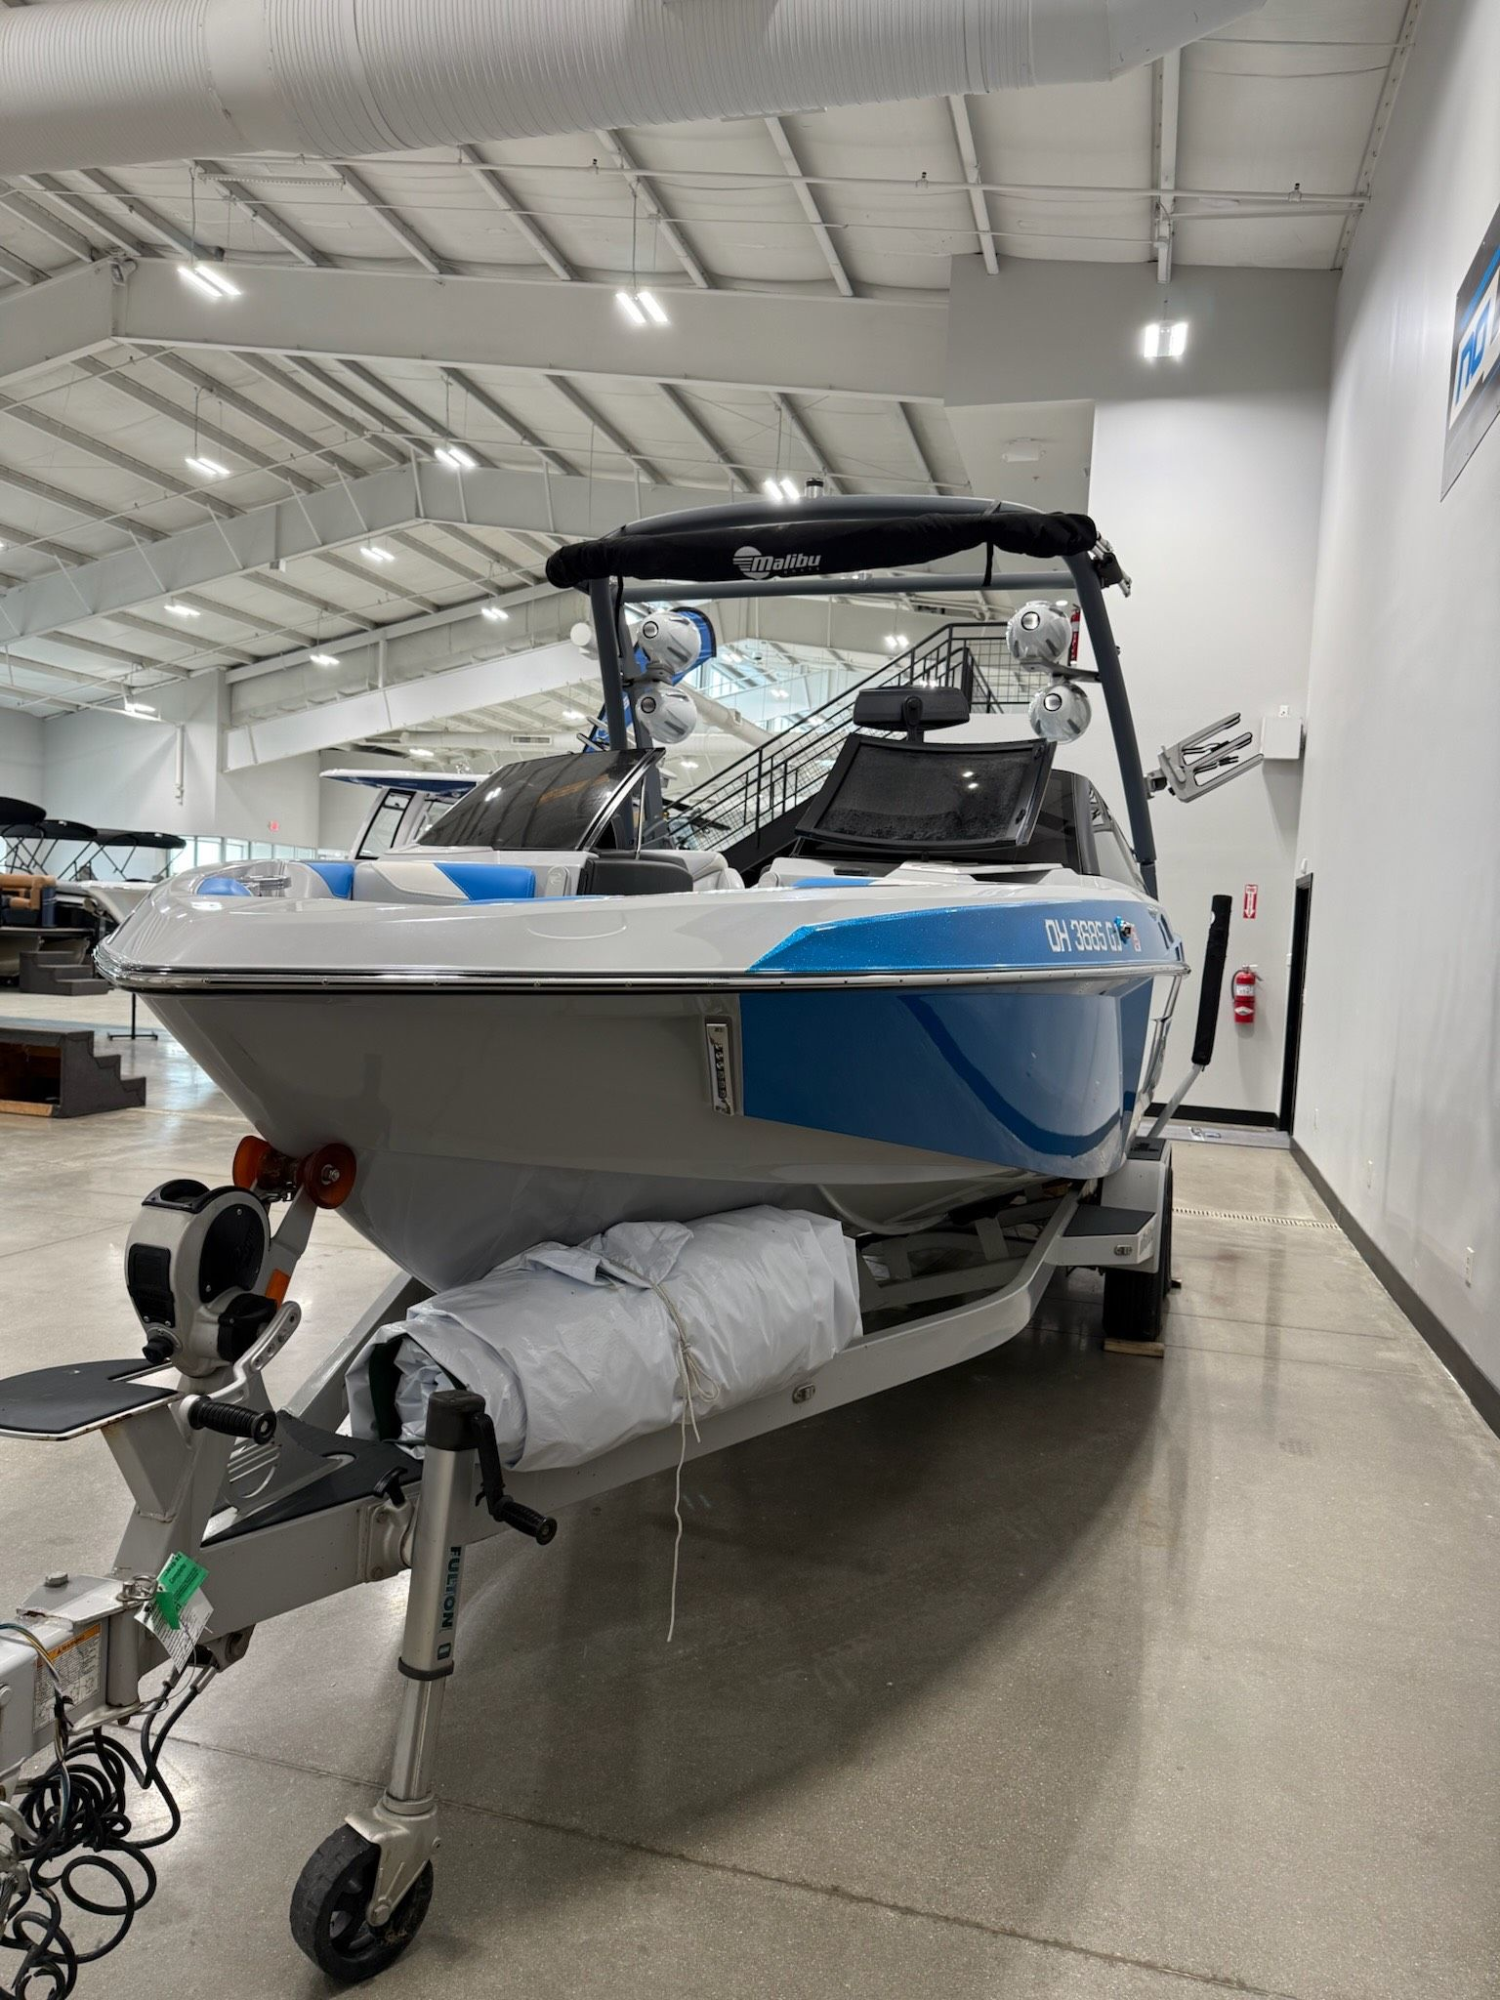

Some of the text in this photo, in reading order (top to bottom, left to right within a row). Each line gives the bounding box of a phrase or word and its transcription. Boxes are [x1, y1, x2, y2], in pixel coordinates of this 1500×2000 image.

[1044, 919, 1072, 952] OH
[1070, 919, 1108, 951] 3685
[441, 1546, 462, 1628] FULTON
